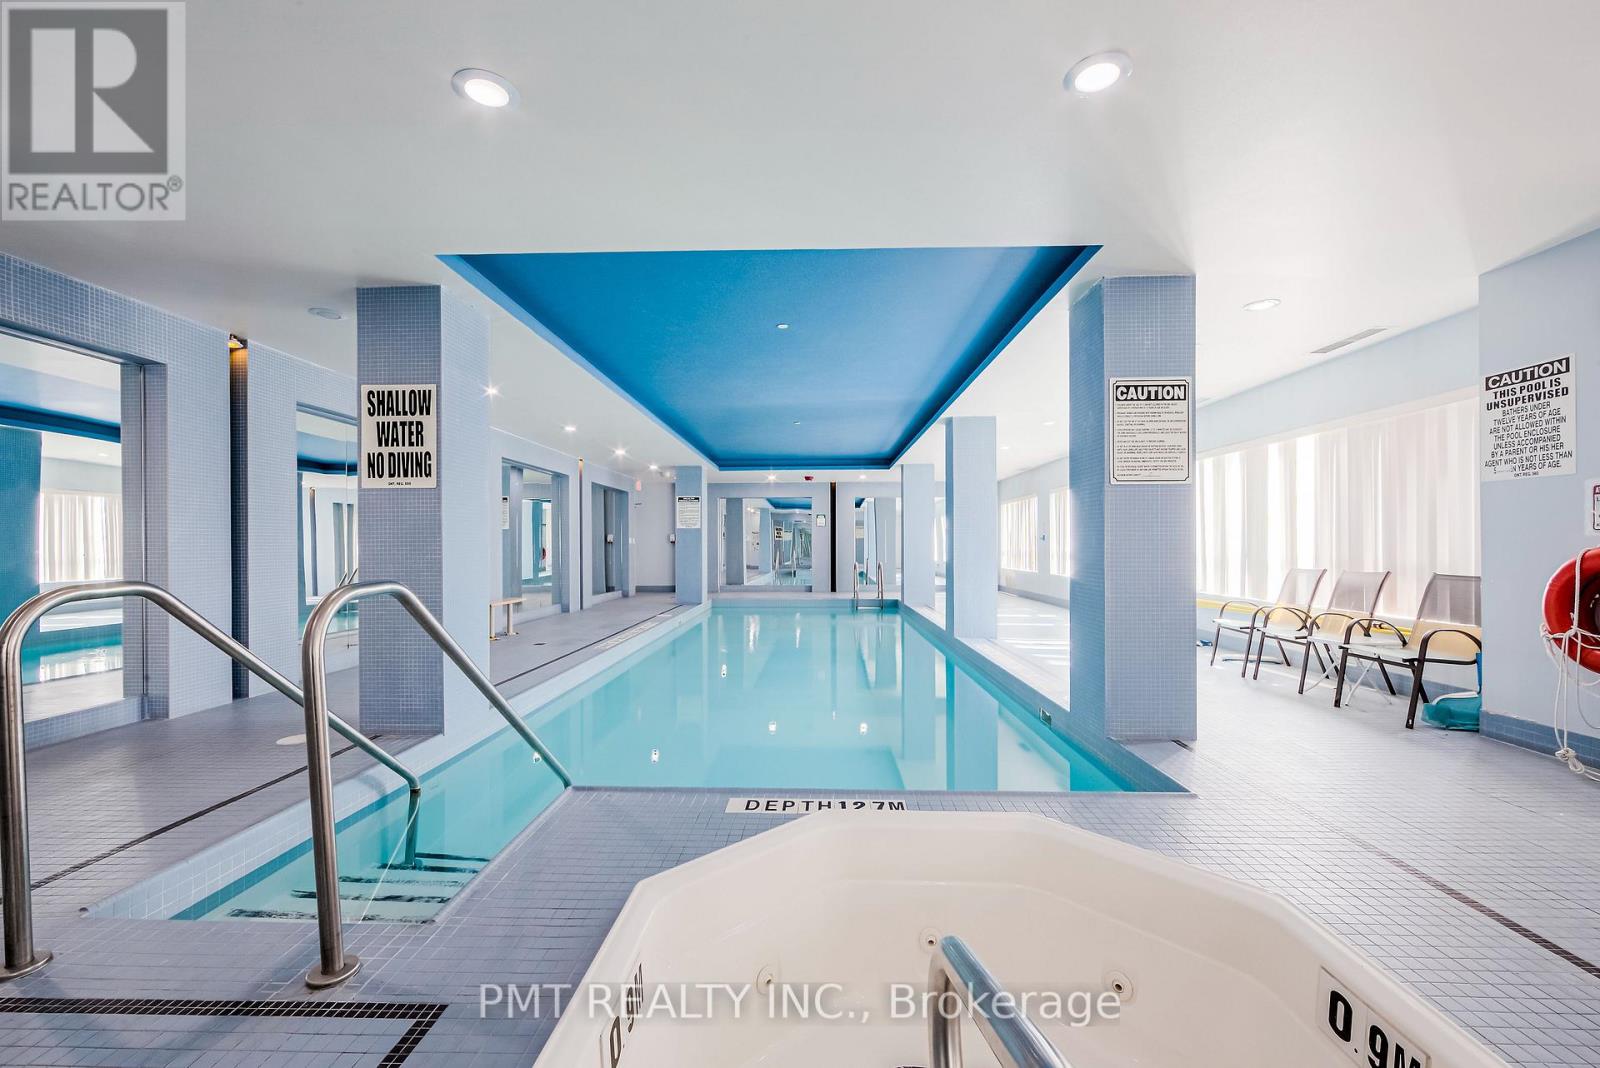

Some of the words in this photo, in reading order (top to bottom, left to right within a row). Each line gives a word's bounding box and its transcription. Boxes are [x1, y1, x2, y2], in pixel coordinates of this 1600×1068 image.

[1488, 359, 1567, 388] CAUTION
[1116, 385, 1185, 400] CAUTION
[1493, 387, 1517, 400] THIS
[1520, 381, 1547, 394] POOL
[1550, 377, 1561, 388] IS
[367, 389, 432, 417] SHALLOW
[1486, 386, 1569, 411] UNSUPERVISED
[1493, 415, 1516, 426] TWELVE
[1517, 412, 1537, 423] YEARS
[1538, 410, 1547, 418] OF
[1548, 407, 1561, 416] AGE
[1502, 405, 1528, 417] BATHERS
[1529, 401, 1551, 412] UNDER
[376, 420, 424, 447] WATER
[1489, 427, 1502, 435] ARE
[1502, 424, 1514, 433] NOT
[1515, 419, 1544, 431] ALLOWED
[1545, 416, 1567, 426] WITHIN
[1494, 434, 1506, 442] THE
[1507, 431, 1522, 441] POOL
[1524, 425, 1561, 438] ENCLOSURE
[1491, 450, 1499, 458] BY
[1505, 446, 1527, 456] PARENT
[1528, 445, 1538, 453] OR
[1540, 443, 1550, 452] HIS
[1551, 442, 1564, 450] HER
[1493, 440, 1516, 450] UNLESS
[1517, 433, 1561, 447] ACCOMPANIED
[367, 452, 385, 479] NO
[388, 451, 432, 478] DIVING
[1485, 459, 1502, 467] AGENT
[1503, 457, 1518, 465] WHO
[1518, 455, 1524, 463] IS
[1525, 454, 1537, 463] NOT
[1538, 452, 1554, 461] LESS
[1556, 450, 1573, 459] THAN
[1517, 462, 1537, 472] YEARS
[1538, 461, 1547, 470] OF
[744, 799, 832, 811] DEPTH
